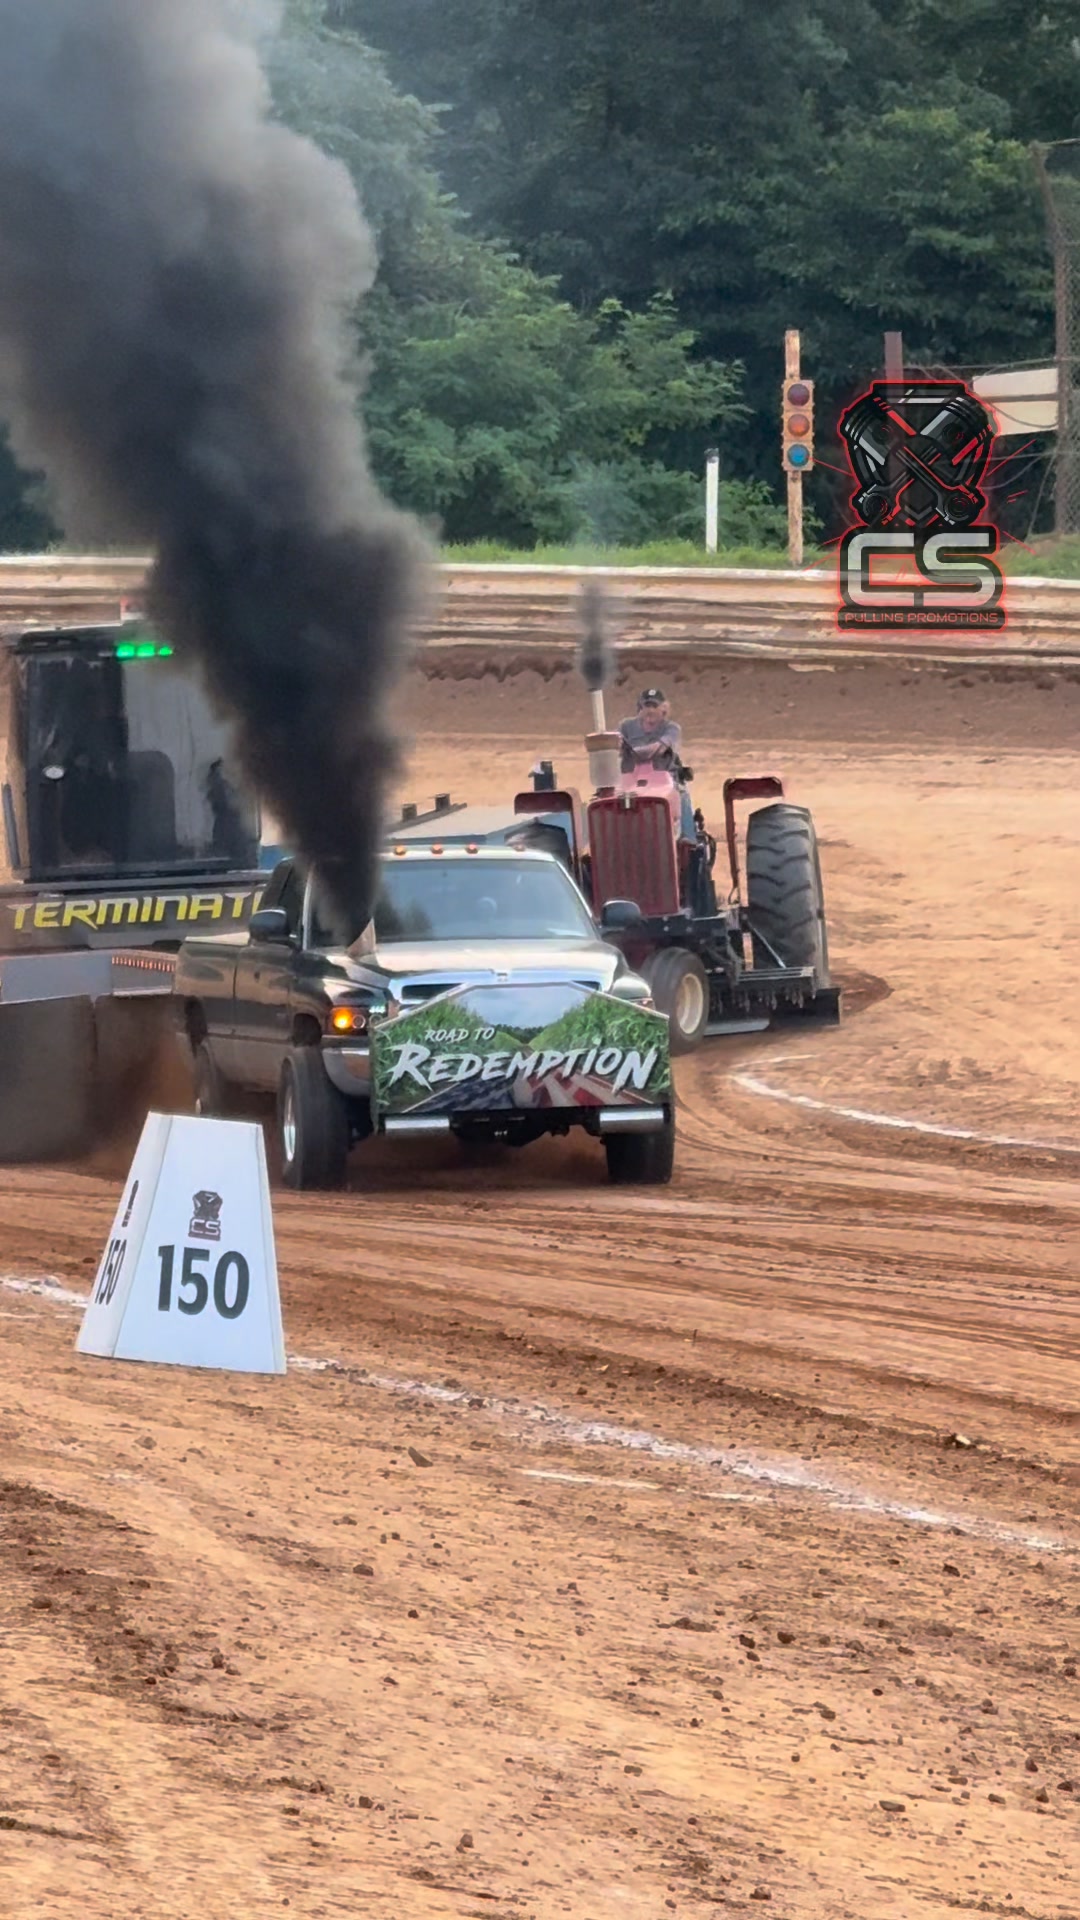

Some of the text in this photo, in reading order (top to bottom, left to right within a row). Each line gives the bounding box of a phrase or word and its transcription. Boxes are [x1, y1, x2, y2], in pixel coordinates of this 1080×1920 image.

[7, 892, 263, 930] TERMINAT
[424, 1027, 495, 1042] ROAD TO
[386, 1040, 658, 1094] REDEMPTION
[94, 1239, 127, 1305] 150
[158, 1245, 250, 1319] 150
